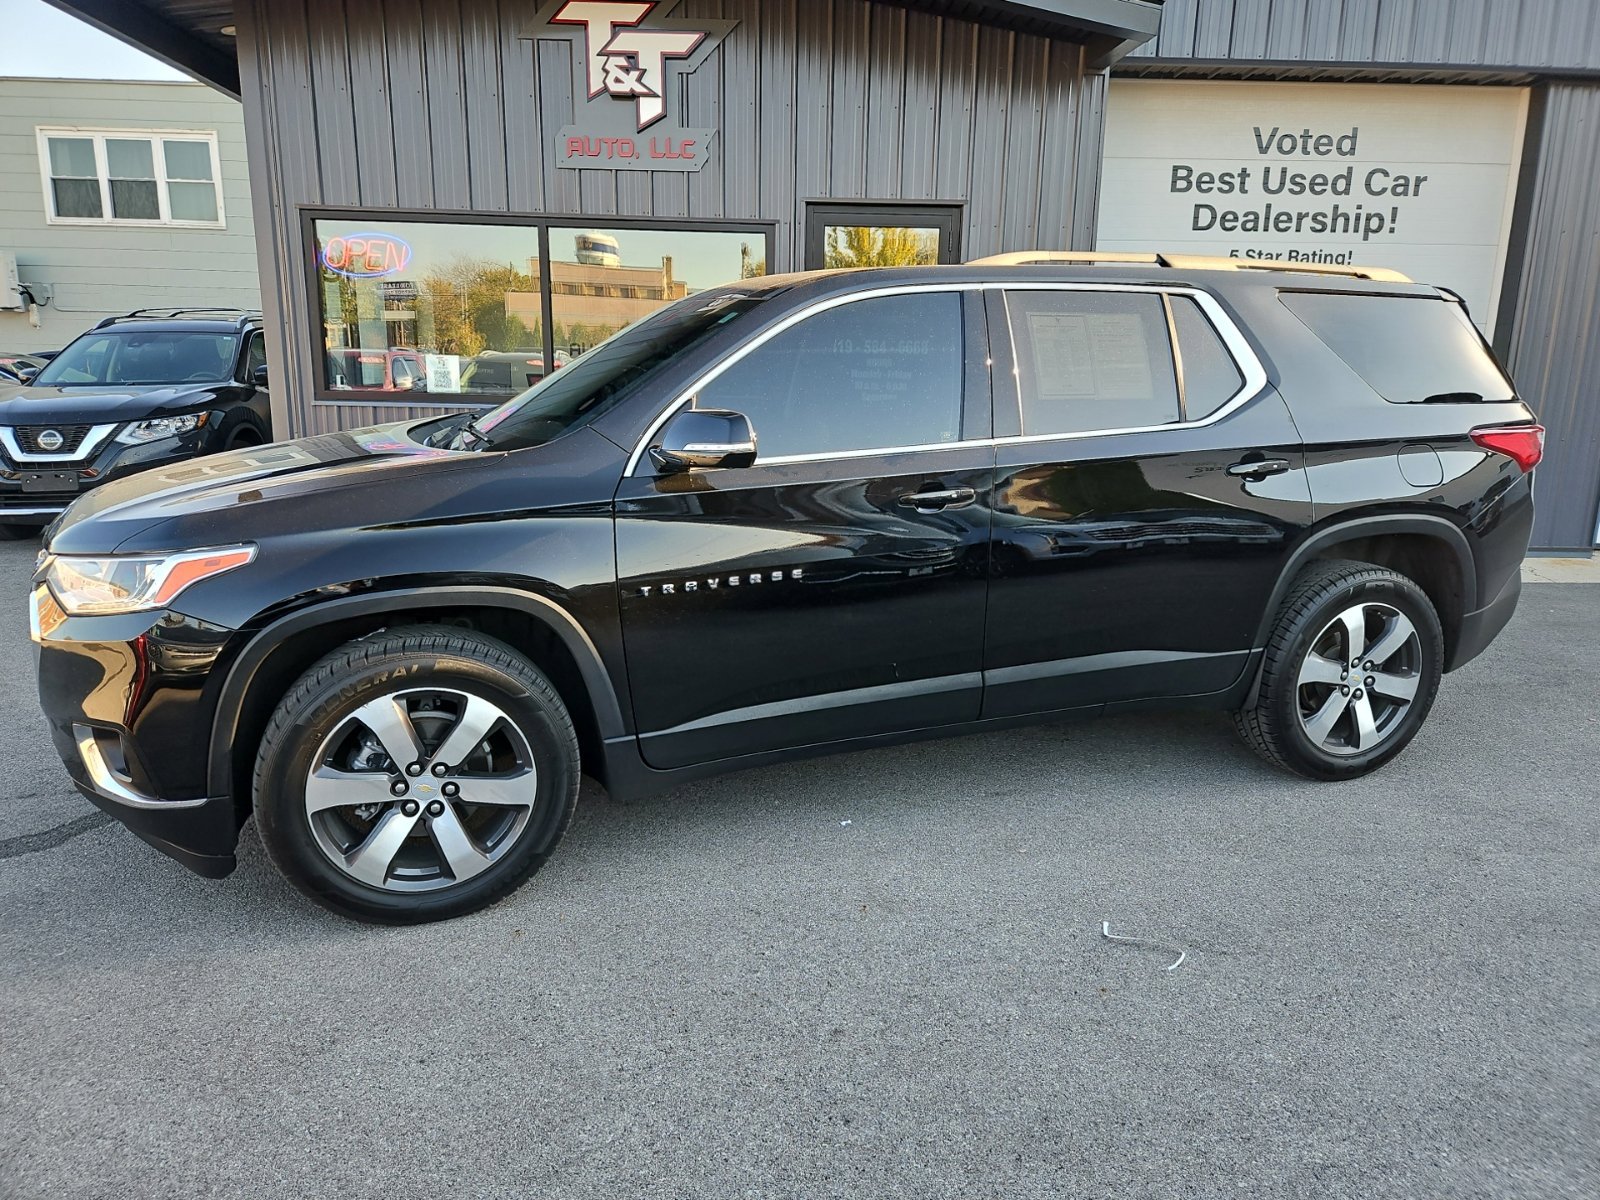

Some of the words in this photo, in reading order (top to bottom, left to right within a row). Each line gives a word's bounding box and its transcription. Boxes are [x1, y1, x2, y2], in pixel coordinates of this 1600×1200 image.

[566, 135, 640, 160] AUTO,
[650, 136, 696, 160] LLC
[1253, 126, 1359, 157] Voted
[1170, 164, 1251, 194] Best
[1262, 166, 1354, 196] Used
[1364, 167, 1428, 197] Car
[1191, 203, 1399, 241] Dealership!
[325, 237, 406, 272] OPEN
[1245, 248, 1283, 261] Star
[1287, 249, 1353, 266] Rating!
[639, 568, 803, 598] TRAVERSE
